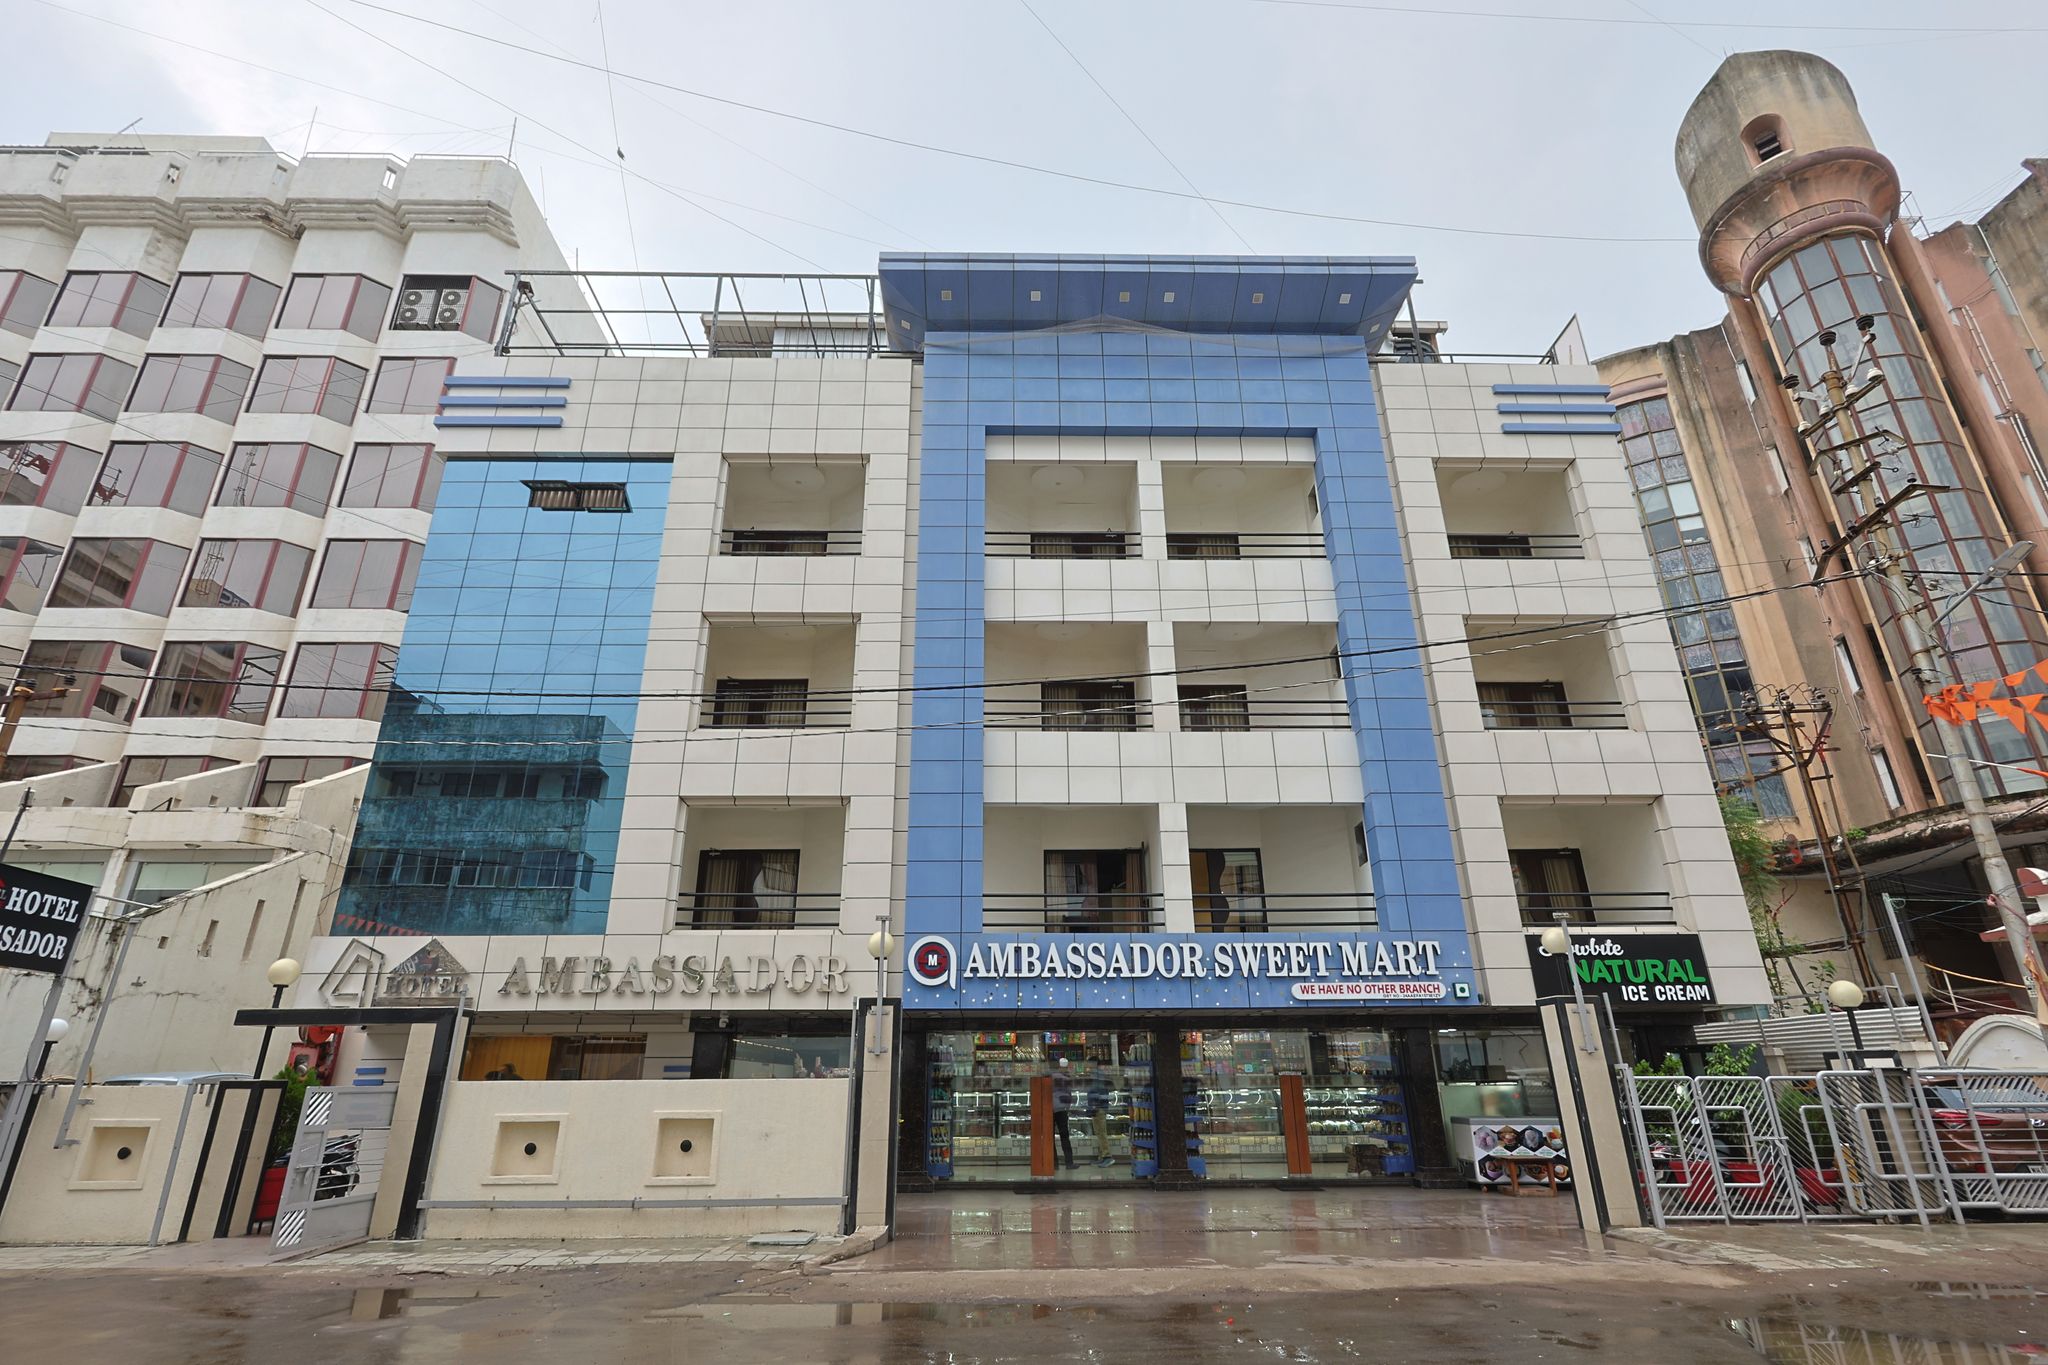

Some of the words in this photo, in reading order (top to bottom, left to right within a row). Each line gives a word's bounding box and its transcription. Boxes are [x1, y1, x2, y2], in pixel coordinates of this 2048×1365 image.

[5, 886, 79, 923] HOTEL
[0, 925, 68, 960] SADOR
[497, 955, 850, 995] AMBASSADOR
[963, 942, 1207, 979] AMBASSADOR
[1214, 942, 1332, 978] SWEET
[1338, 941, 1441, 976] MART
[1568, 959, 1706, 984] NATURAL
[383, 976, 468, 994] HOTEL
[1300, 985, 1315, 995] WE
[1318, 985, 1345, 995] HAVE
[1347, 984, 1361, 994] NO
[1364, 984, 1398, 994] OTHER
[1399, 984, 1441, 994] BRANCH
[1621, 985, 1649, 1001] ICE
[1655, 985, 1711, 1001] CREAM
